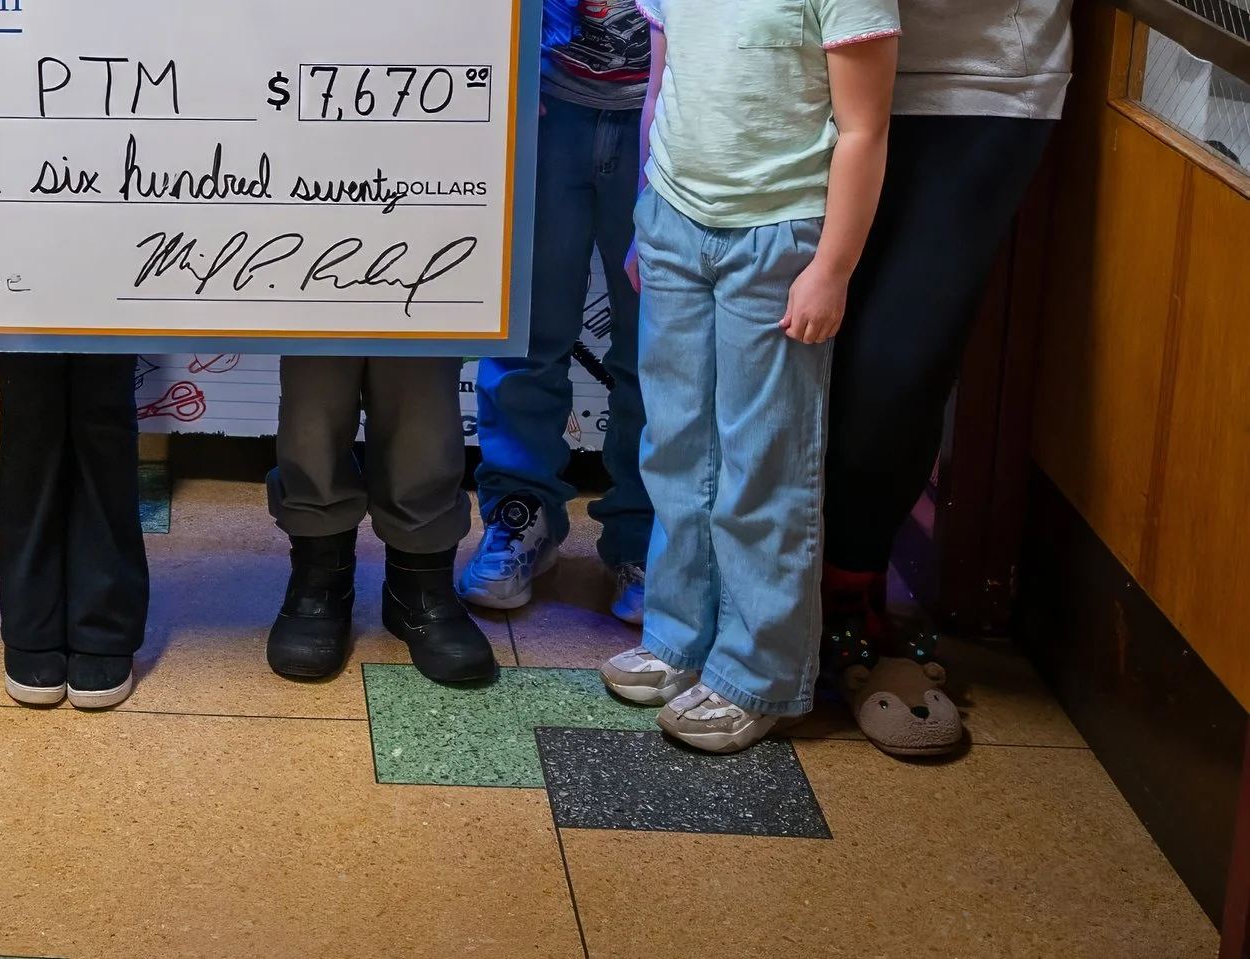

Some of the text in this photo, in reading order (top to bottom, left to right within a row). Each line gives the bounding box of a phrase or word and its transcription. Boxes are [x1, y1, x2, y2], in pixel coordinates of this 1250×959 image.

[38, 56, 180, 118] PTM
[267, 70, 291, 111] $
[30, 156, 100, 195] six
[120, 133, 273, 201] hundred
[290, 168, 406, 214] seventy
[396, 180, 487, 196] DOLLARS
